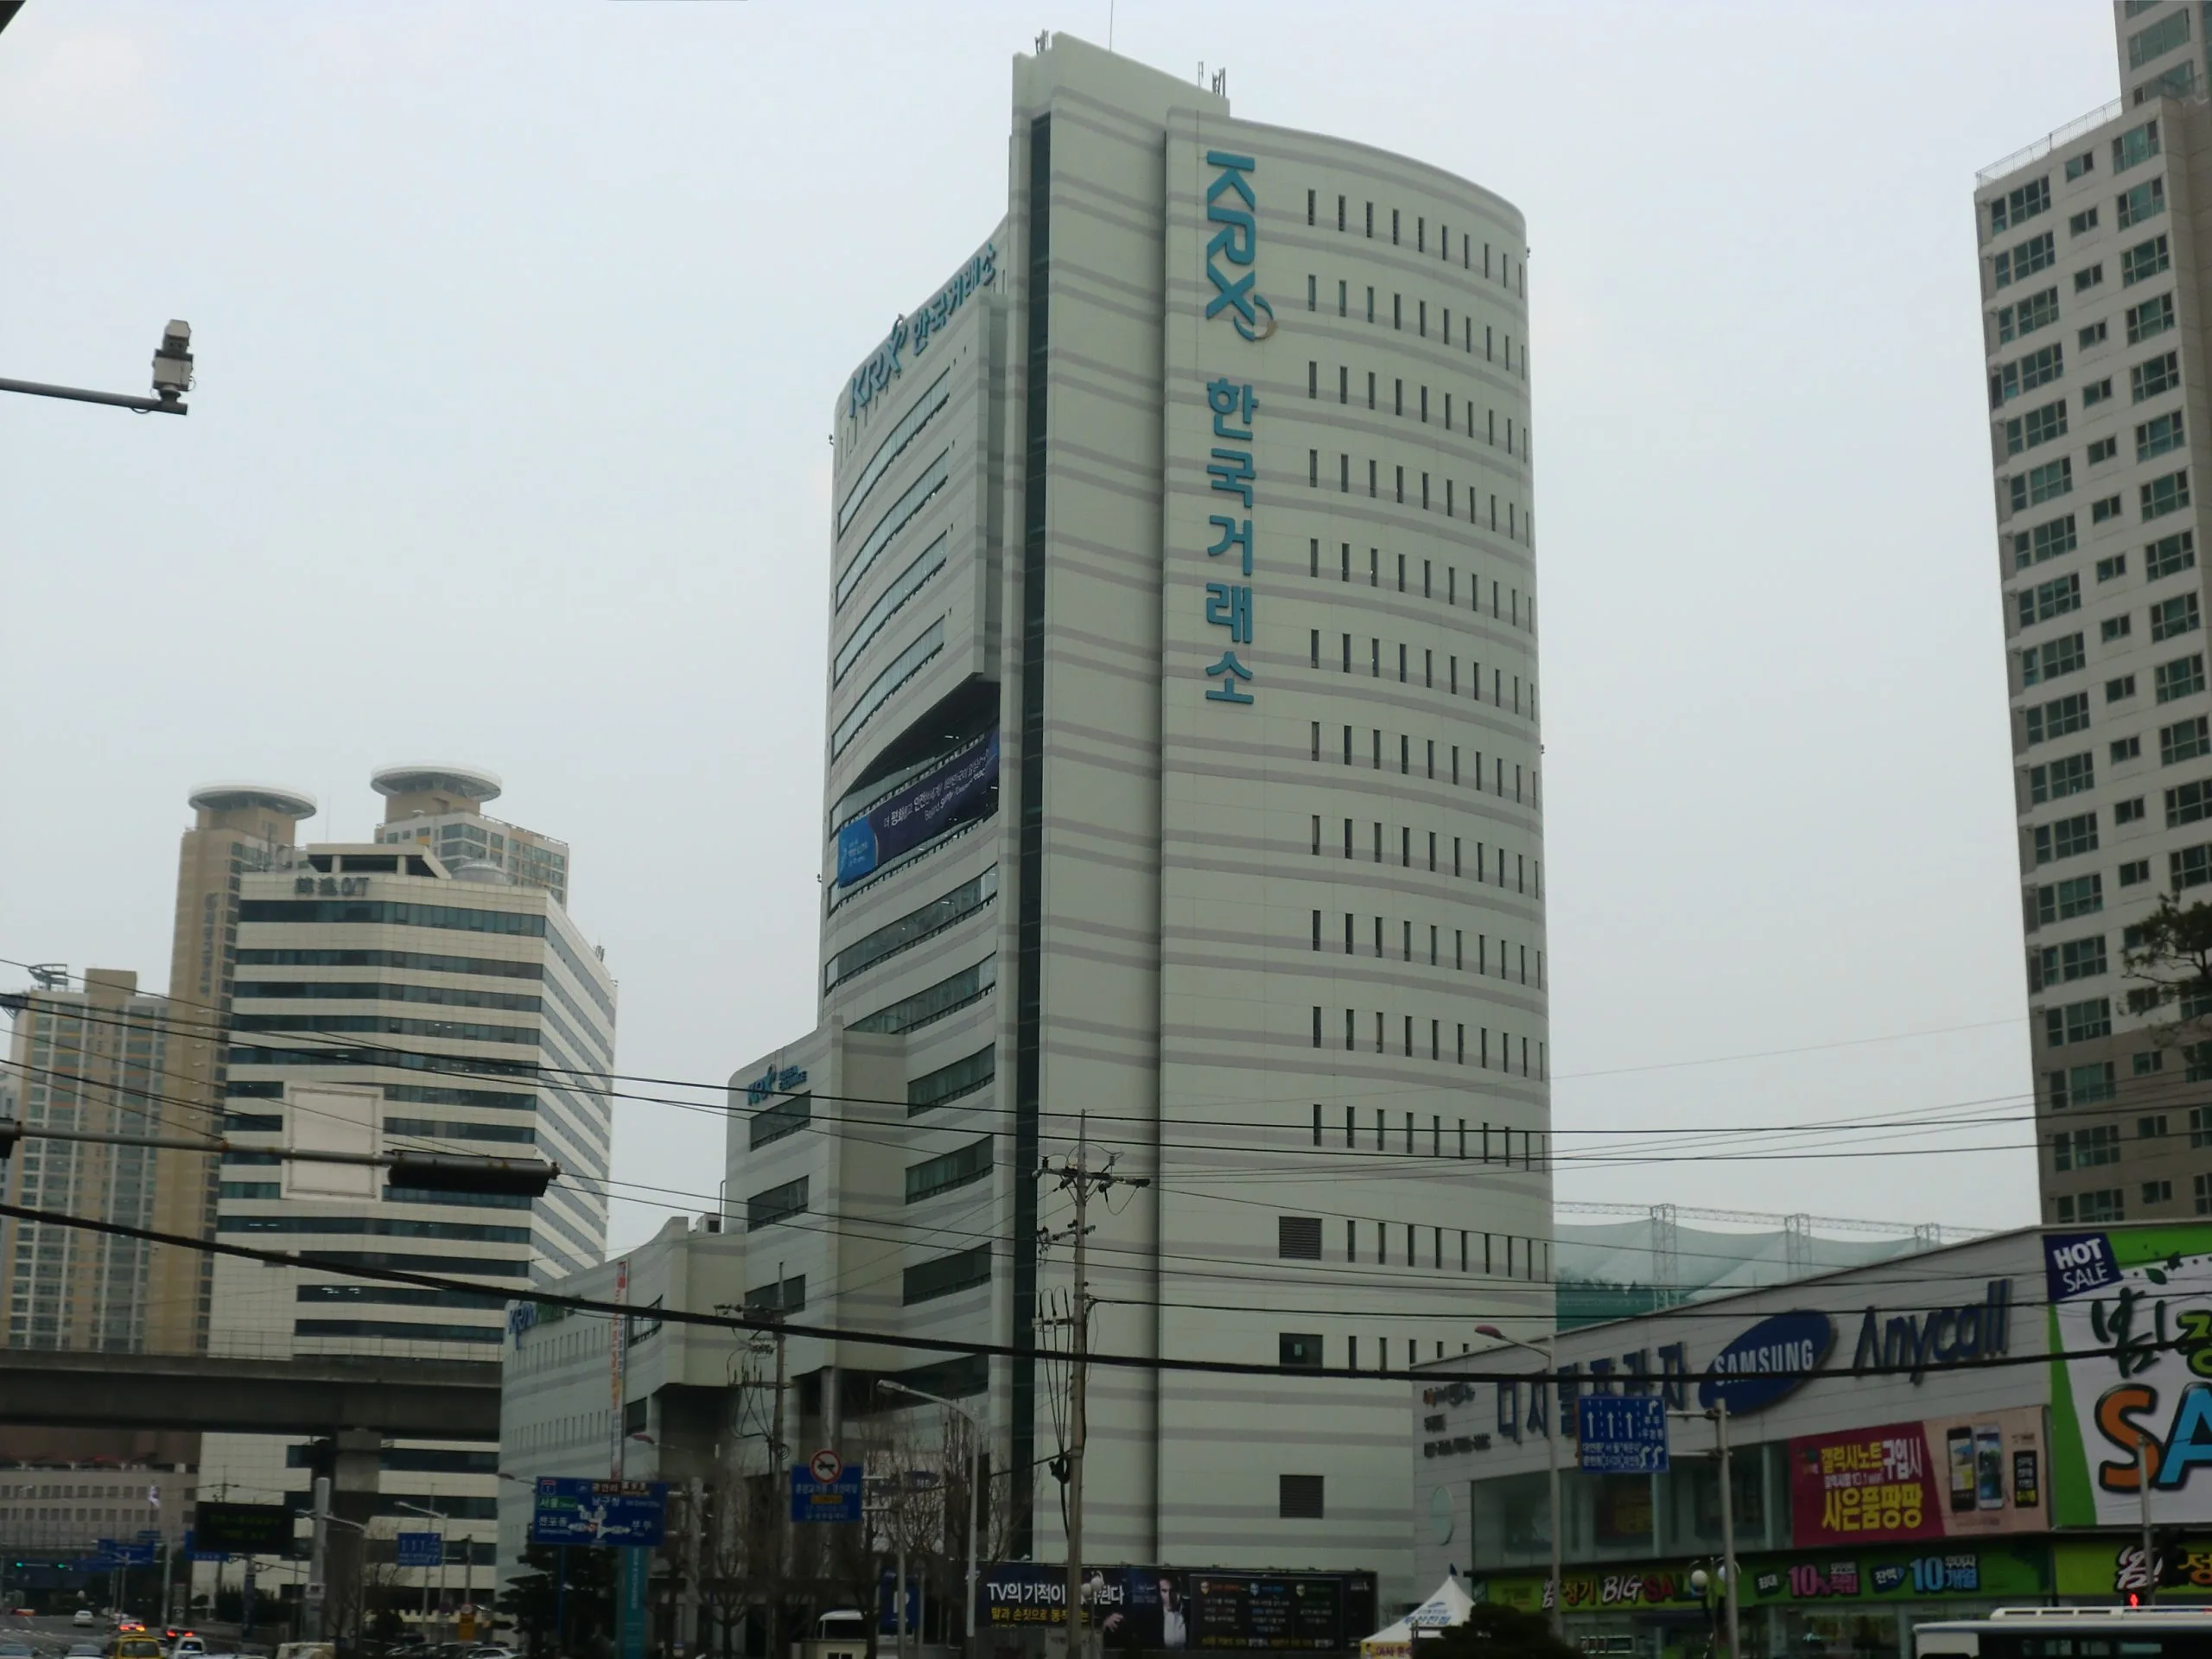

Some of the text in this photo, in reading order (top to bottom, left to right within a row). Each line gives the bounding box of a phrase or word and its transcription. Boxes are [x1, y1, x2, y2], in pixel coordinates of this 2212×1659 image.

[1206, 149, 1256, 327] KRX
[849, 243, 997, 418] KRX 한국거래소
[1205, 377, 1259, 705] 한국거래소
[2054, 1238, 2102, 1271] HOT
[2063, 1262, 2109, 1294] SALE
[1715, 1339, 1815, 1387] SAMSUNG
[1821, 1441, 1883, 1474] 갤럭시노트
[1602, 1575, 1643, 1603] BIG
[1910, 1556, 1944, 1592] 10
[986, 1582, 1022, 1605] TV의
[1024, 1582, 1066, 1605] 기적이
[991, 1607, 1010, 1621] 말과
[1013, 1607, 1048, 1622] 손짓으로
